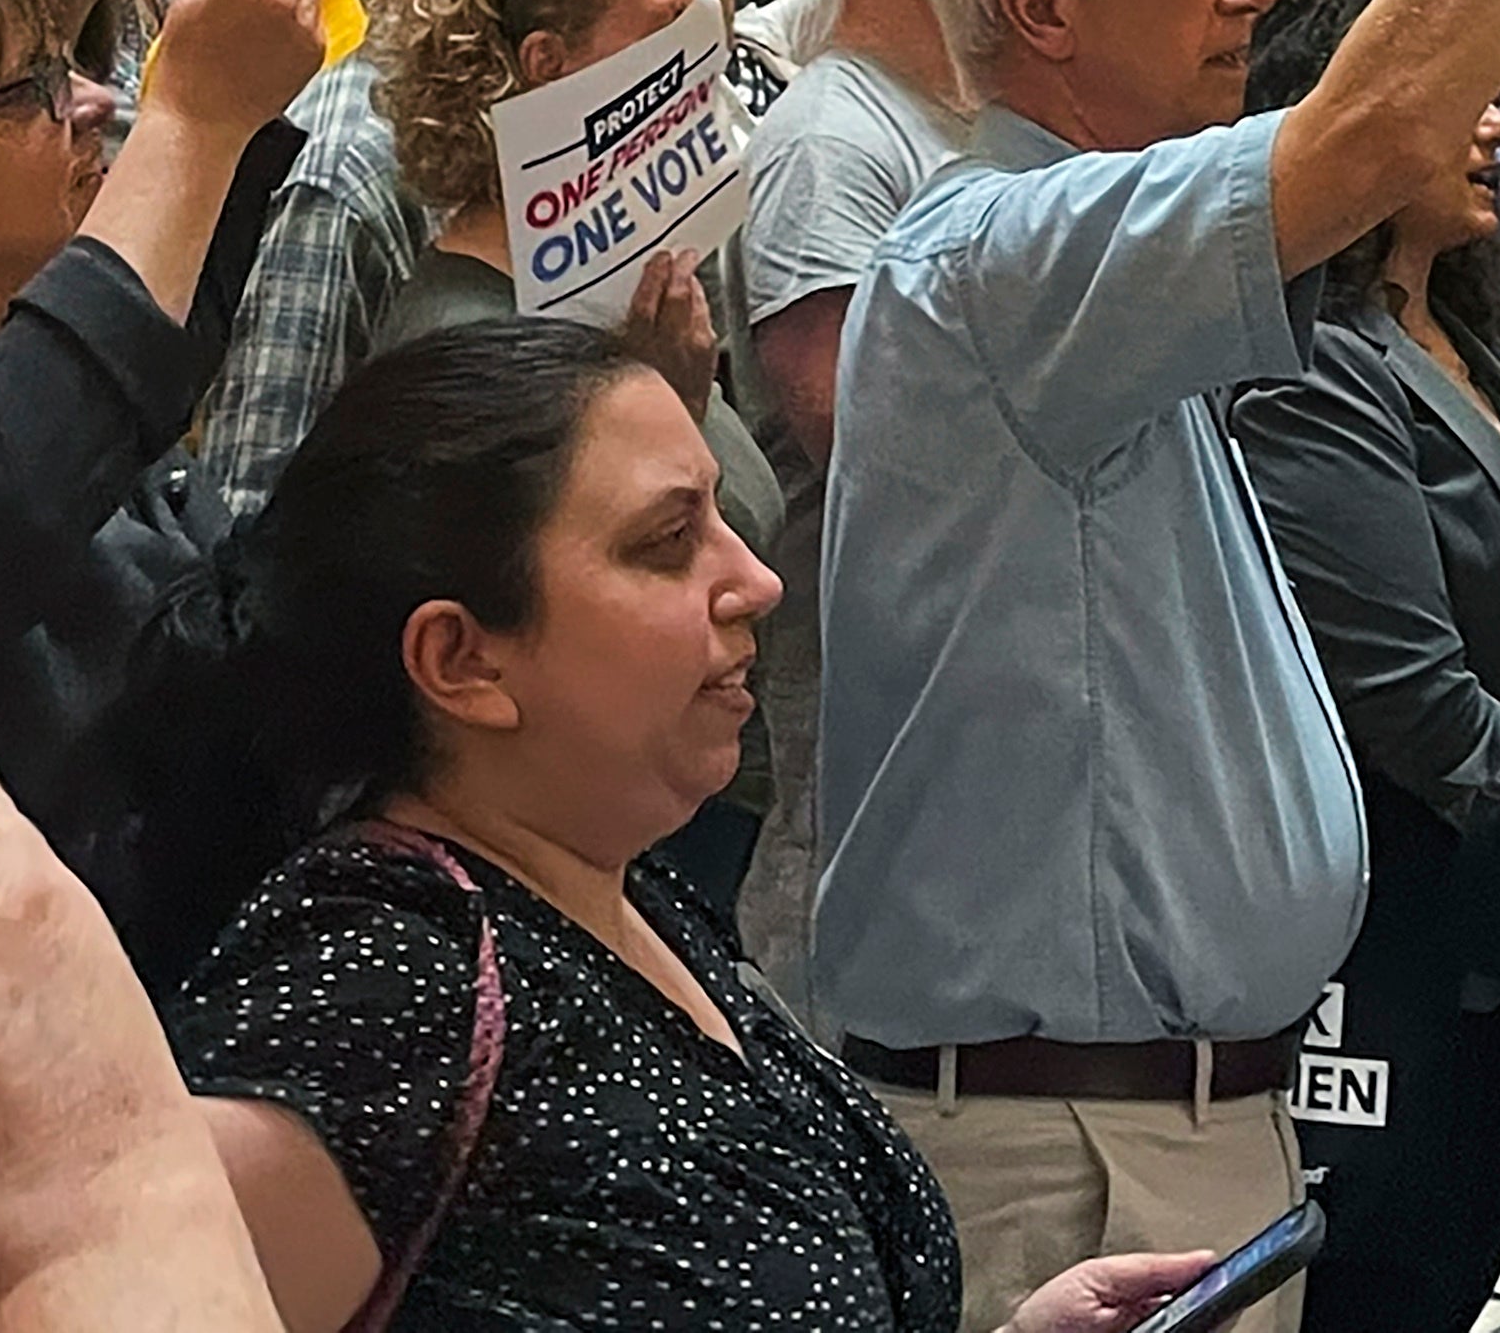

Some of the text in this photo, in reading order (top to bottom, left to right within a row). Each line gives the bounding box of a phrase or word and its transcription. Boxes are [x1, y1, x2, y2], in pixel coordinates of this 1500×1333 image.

[526, 74, 716, 229] ONE PERSON
[594, 62, 681, 145] PROTECT
[532, 112, 728, 283] ONE VOTE
[1291, 1064, 1378, 1115] EN
